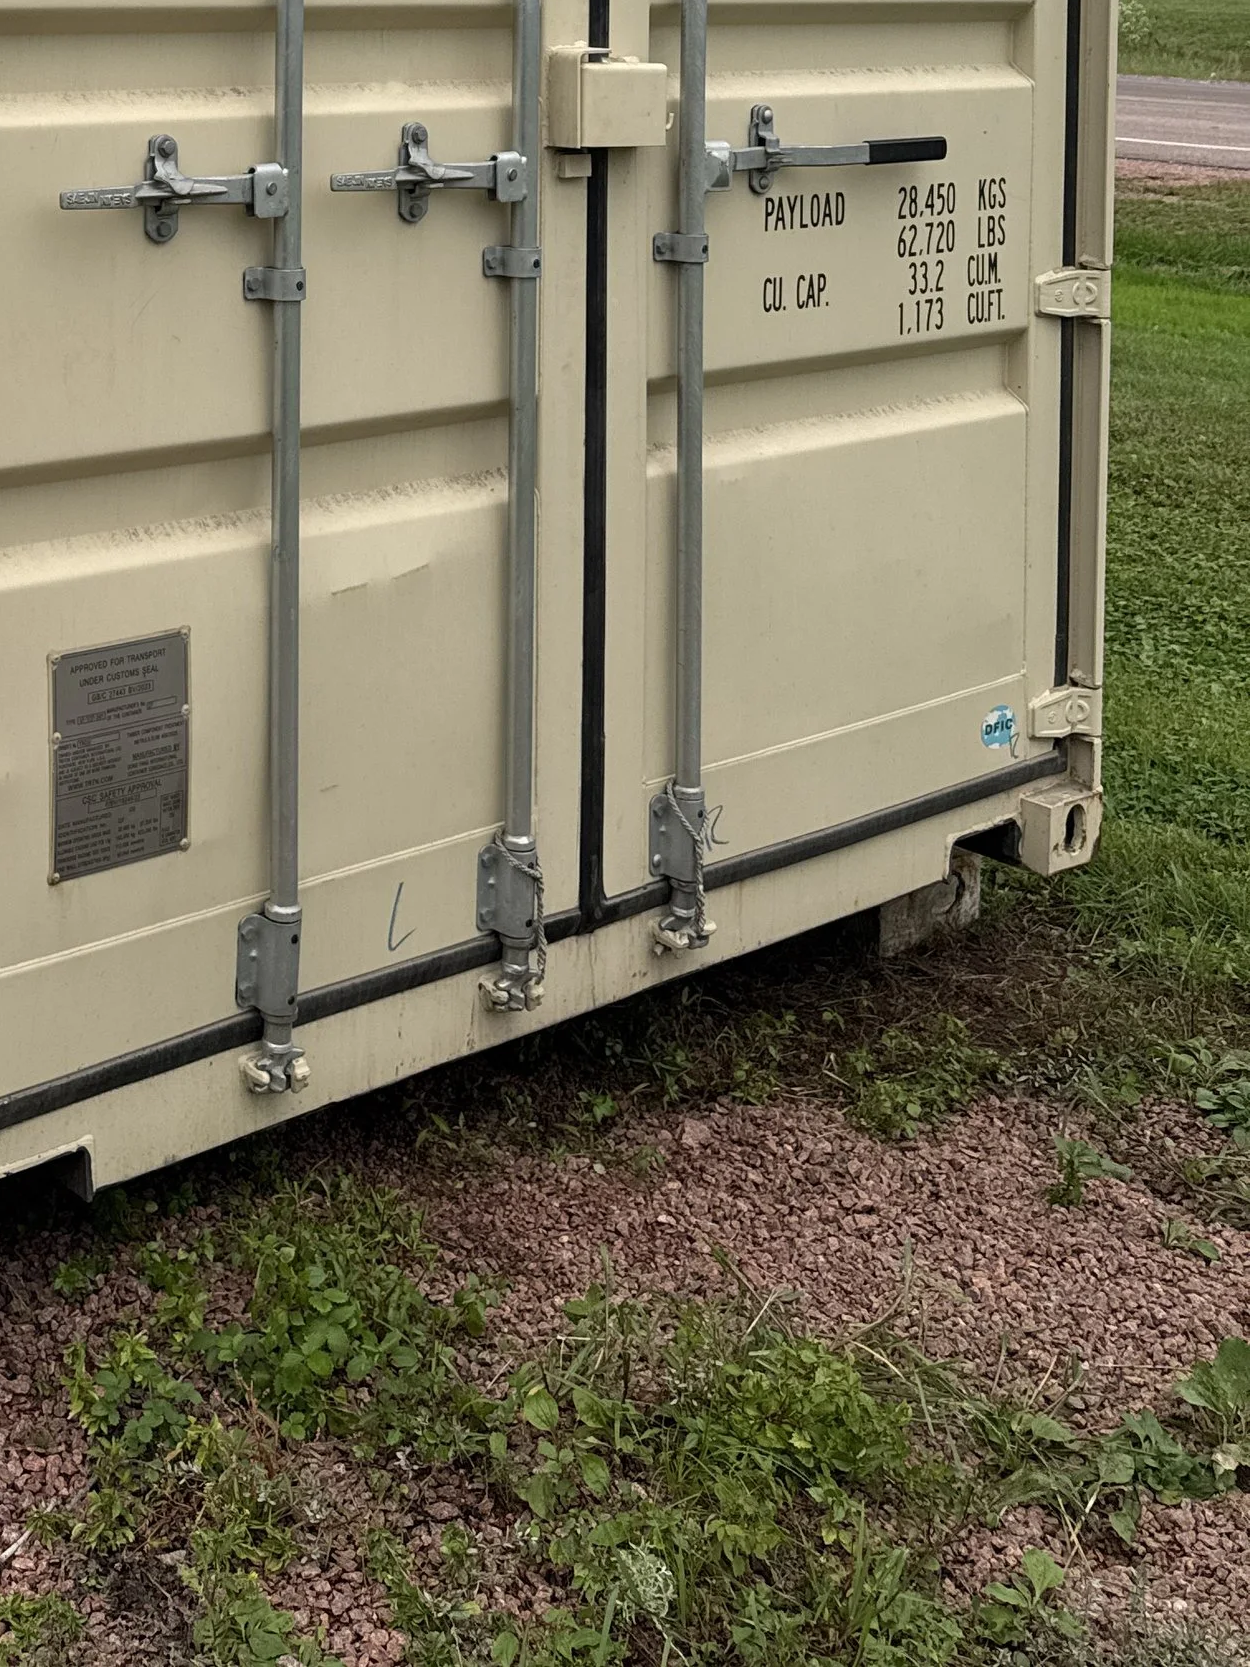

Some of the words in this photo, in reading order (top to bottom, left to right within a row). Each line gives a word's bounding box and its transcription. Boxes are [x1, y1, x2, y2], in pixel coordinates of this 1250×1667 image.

[764, 192, 845, 231] PAYLOAD
[898, 182, 956, 219] 28,450
[978, 177, 1006, 211] KGS
[897, 219, 955, 258] 62,720
[977, 215, 1006, 248] LBS
[763, 277, 786, 313] CU.
[796, 273, 829, 309] CAP.
[908, 260, 944, 295] 33.2
[898, 297, 944, 335] 1,173
[70, 660, 107, 675] APPROVED
[110, 656, 124, 666] FOR
[127, 648, 166, 663] TRANSPORT
[79, 675, 104, 687] UNDER
[106, 668, 139, 682] CUSTOMS
[142, 665, 158, 676] SEAL
[984, 718, 1013, 736] DFIC
[82, 794, 96, 805] CSC
[99, 787, 126, 802] SAFETY
[128, 778, 162, 793] APPROVAL
